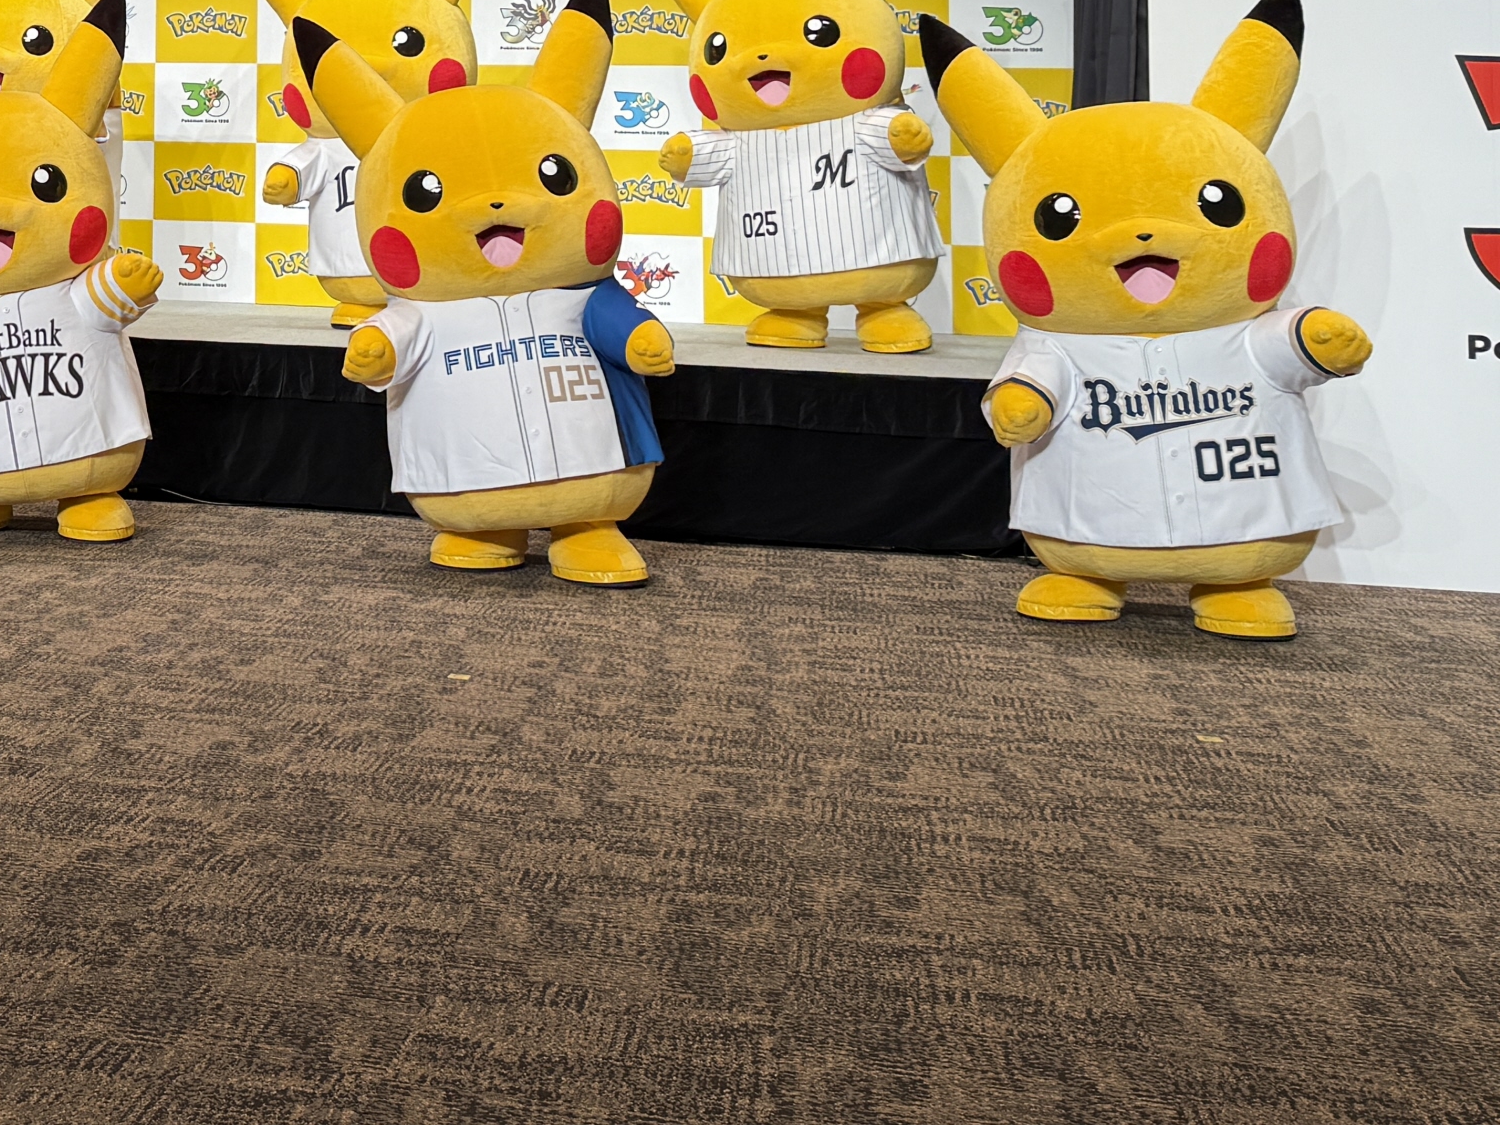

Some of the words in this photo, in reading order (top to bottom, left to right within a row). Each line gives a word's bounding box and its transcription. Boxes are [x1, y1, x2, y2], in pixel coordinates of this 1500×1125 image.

[165, 9, 248, 38] Pokémon
[162, 164, 246, 196] Pokémon
[810, 148, 856, 192] M
[614, 174, 690, 208] okémon
[742, 210, 779, 238] 025
[442, 333, 593, 375] FIGHTERS
[542, 364, 606, 403] 025
[1079, 376, 1258, 441] Buffaloes
[1194, 433, 1282, 483] 025
